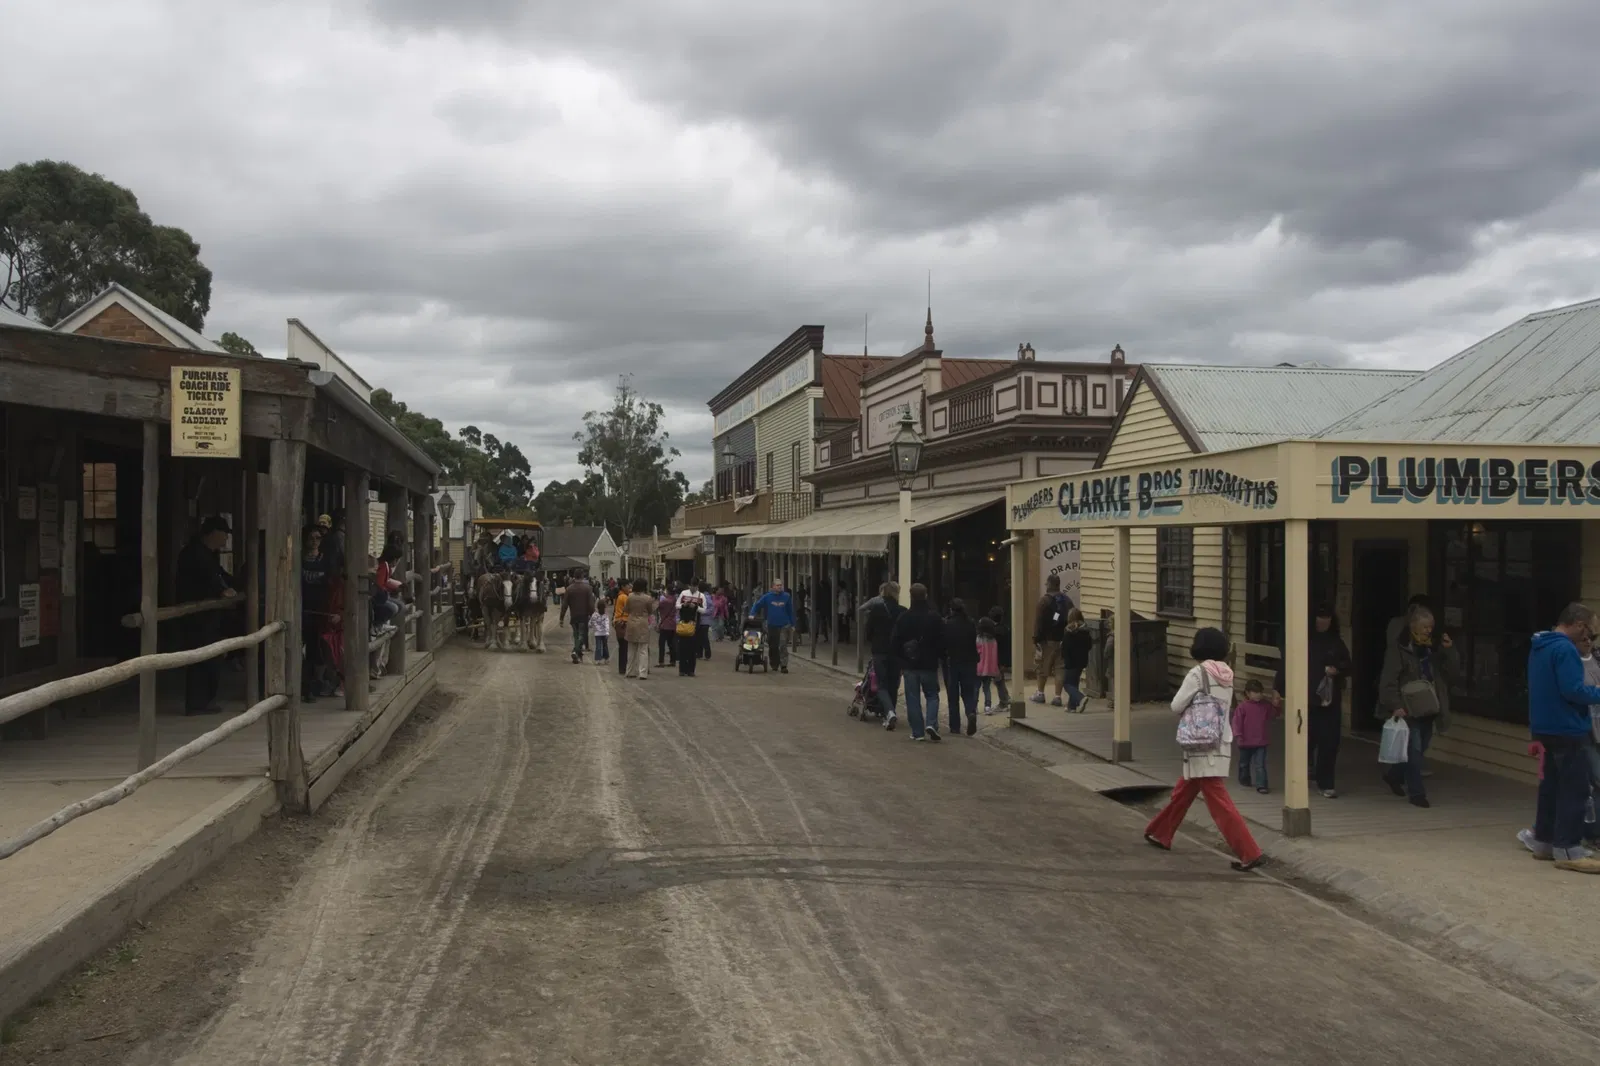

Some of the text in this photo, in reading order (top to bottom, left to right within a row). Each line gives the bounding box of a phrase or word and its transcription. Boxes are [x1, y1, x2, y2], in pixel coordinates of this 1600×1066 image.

[182, 370, 228, 381] PURCHASE
[179, 381, 231, 392] COACH RIDE
[187, 391, 224, 401] TICKETS
[183, 407, 227, 416] GLASGOW
[181, 416, 229, 425] SADDLERY
[1012, 486, 1054, 522] PLUMBERS
[1058, 475, 1131, 519] CLARKE
[1189, 468, 1279, 509] TINSMITHS
